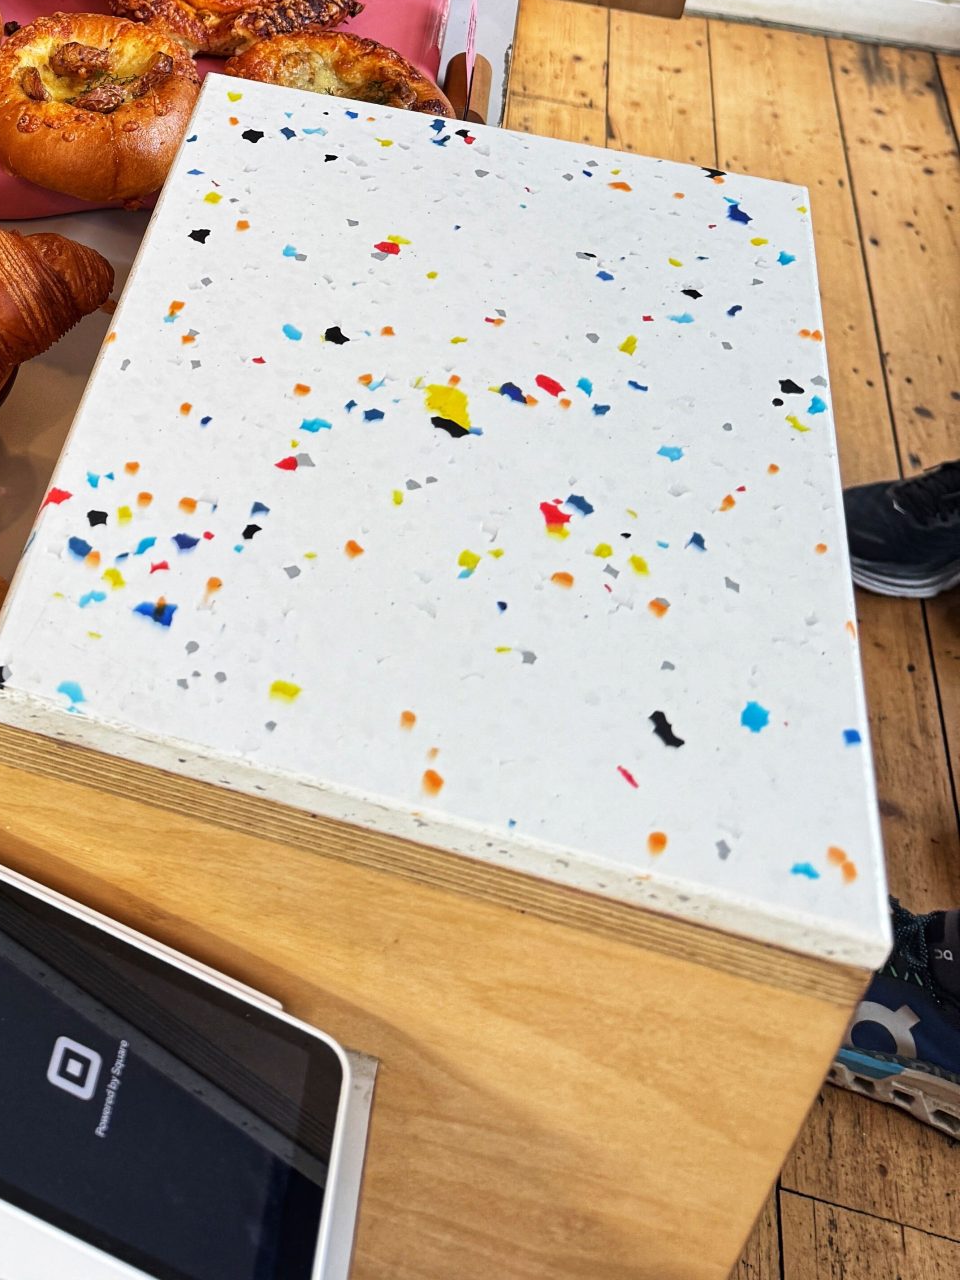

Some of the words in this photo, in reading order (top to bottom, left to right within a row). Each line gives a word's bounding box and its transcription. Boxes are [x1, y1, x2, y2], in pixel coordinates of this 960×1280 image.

[110, 1039, 129, 1077] Square
[107, 1074, 122, 1091] by
[94, 1088, 117, 1138] Powered
